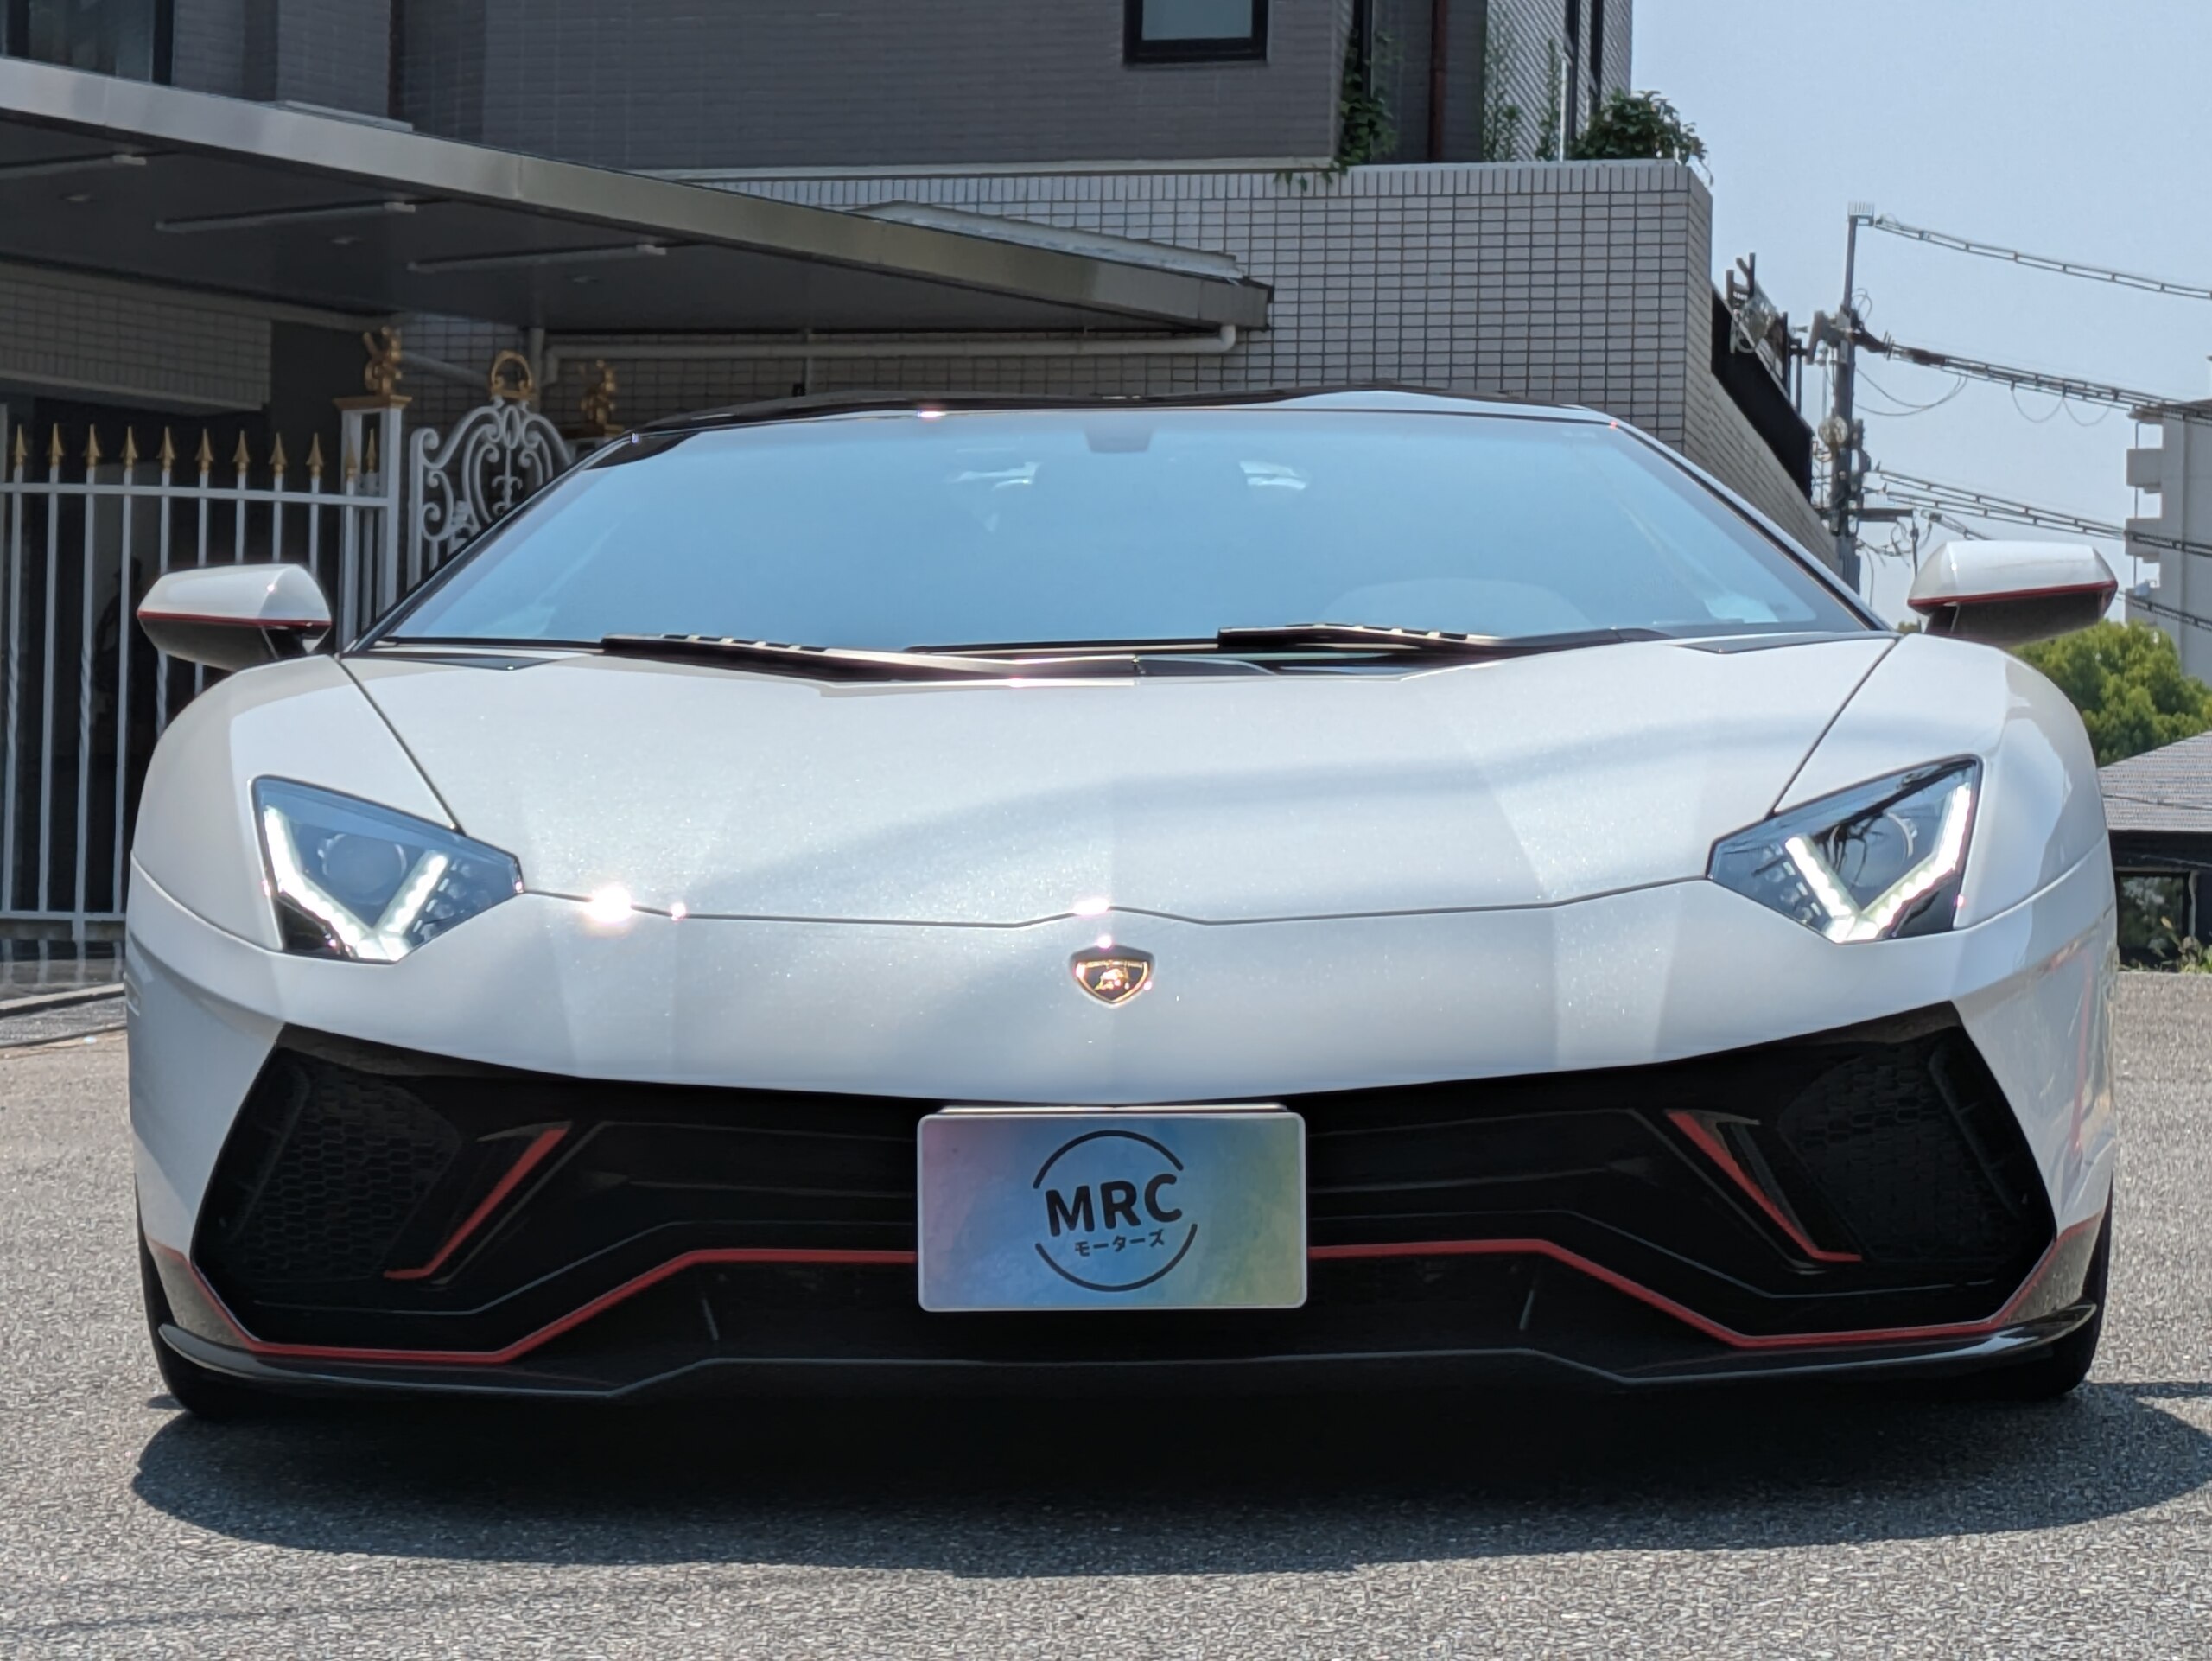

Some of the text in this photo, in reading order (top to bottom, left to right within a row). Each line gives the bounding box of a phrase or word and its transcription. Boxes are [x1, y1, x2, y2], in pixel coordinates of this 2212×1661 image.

[1045, 1174, 1183, 1237] MRC
[1074, 1228, 1166, 1257] モーターズ
